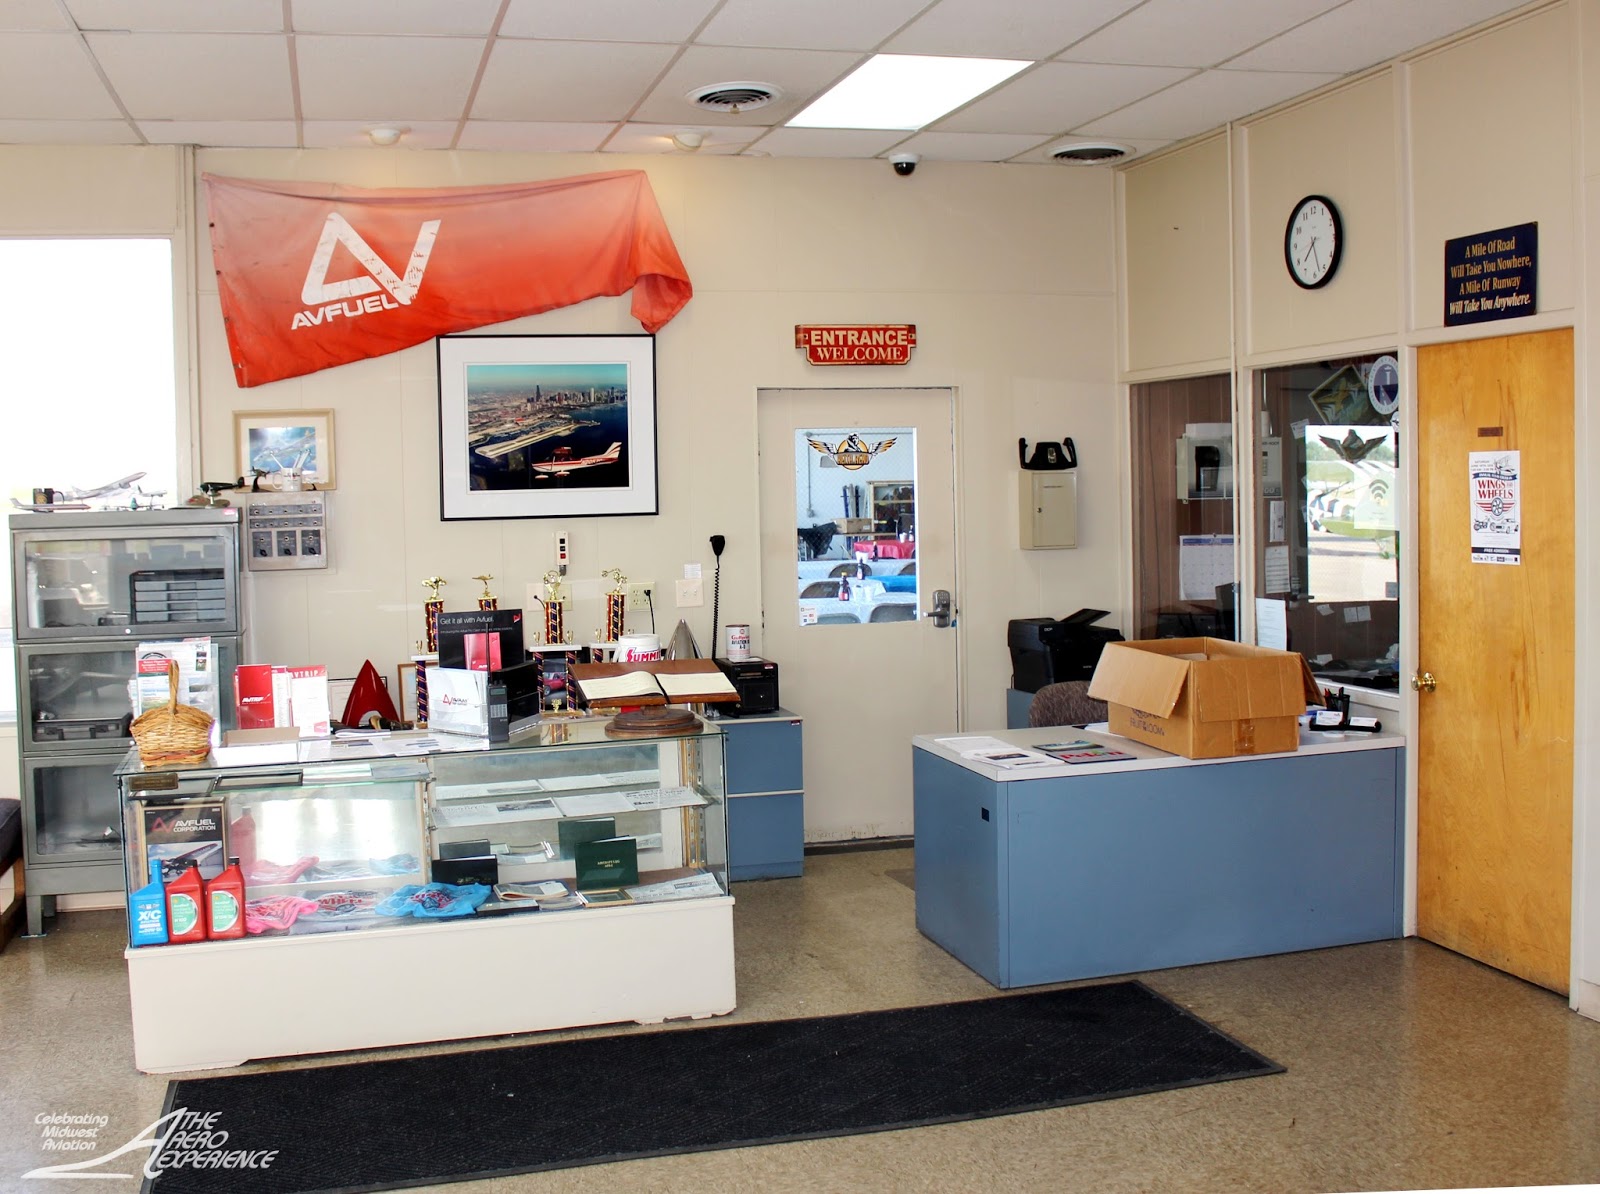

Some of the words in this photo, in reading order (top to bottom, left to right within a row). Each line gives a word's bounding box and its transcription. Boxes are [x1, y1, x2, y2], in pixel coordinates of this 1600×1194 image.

[1465, 246, 1471, 258] A
[1471, 242, 1486, 256] Mile
[1487, 240, 1497, 254] Of
[1497, 236, 1515, 252] Road
[1451, 264, 1464, 279] Will
[1465, 262, 1482, 276] Take
[1483, 260, 1496, 273] You
[1497, 255, 1532, 271] Nowhere,
[1459, 283, 1465, 295] A
[1465, 281, 1481, 294] Mile
[1482, 278, 1491, 291] Of
[1492, 276, 1521, 290] Runway
[1450, 300, 1463, 315] Will
[1464, 299, 1480, 313] Take
[1481, 297, 1493, 311] You
[1493, 292, 1531, 311] Anywhere.
[291, 294, 399, 330] AVFUEL
[810, 330, 908, 346] ENTRANCE
[816, 346, 903, 361] WELCOME
[1477, 479, 1506, 489] WINGS
[1477, 489, 1514, 499] WHEELS
[440, 617, 451, 625] Get
[463, 616, 476, 624] with
[626, 648, 660, 662] SUMMI
[291, 670, 319, 678] AVTRIP
[173, 825, 216, 833] CORPORATION
[175, 818, 216, 827] AVFUEL
